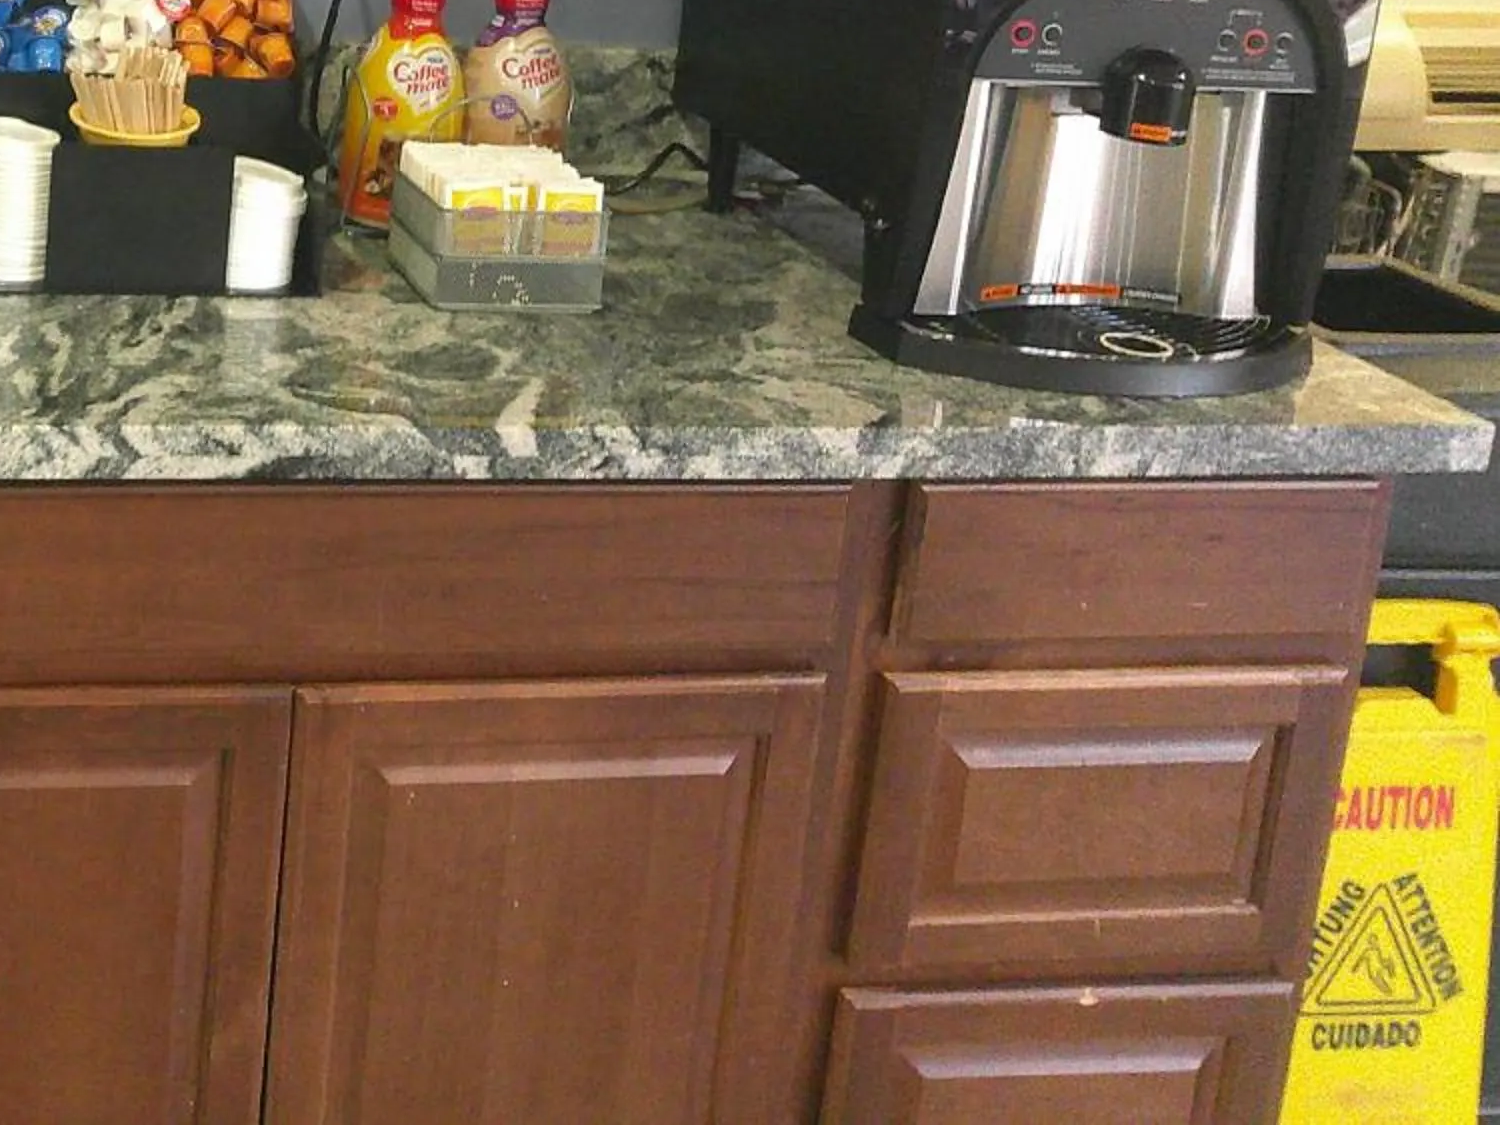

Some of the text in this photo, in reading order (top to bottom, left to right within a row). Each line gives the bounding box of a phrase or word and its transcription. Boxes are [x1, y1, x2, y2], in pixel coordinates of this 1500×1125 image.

[394, 59, 449, 83] Coffee
[501, 52, 559, 79] Coffee
[521, 67, 561, 89] mate
[406, 74, 449, 94] mate
[1332, 784, 1454, 830] CAUTION
[1392, 872, 1464, 1002] ATTENTION
[1311, 1021, 1422, 1051] CUIDADO
